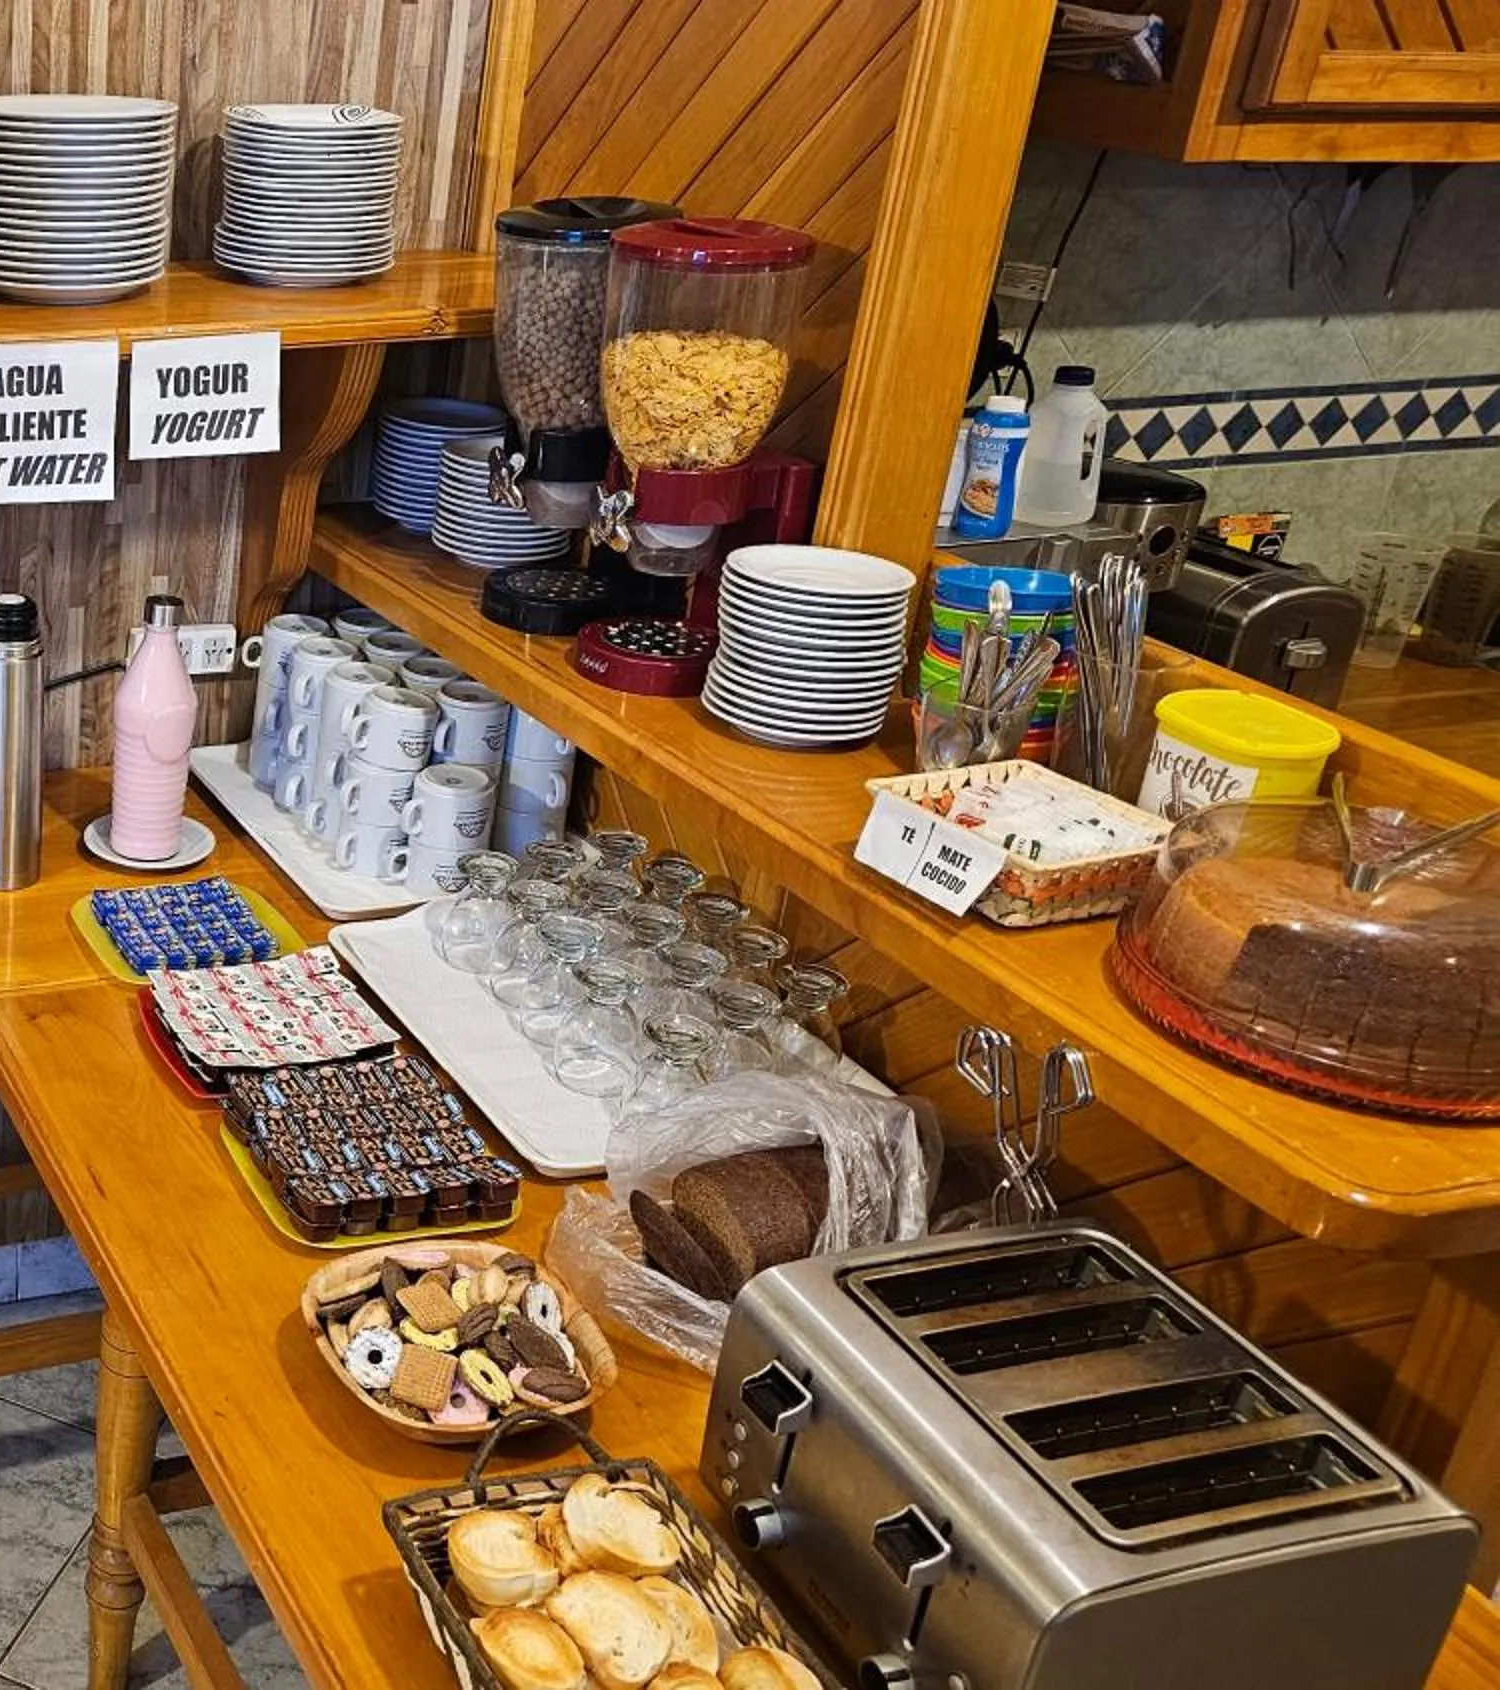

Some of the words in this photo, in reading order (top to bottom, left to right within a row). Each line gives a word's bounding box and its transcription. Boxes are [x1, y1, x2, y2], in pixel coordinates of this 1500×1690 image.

[156, 361, 249, 399] YOGUR
[150, 406, 264, 445] YOGURT
[7, 453, 108, 487] WATER
[1151, 738, 1242, 803] hocolate
[937, 845, 973, 872] MATE
[921, 861, 967, 895] COCIDO
